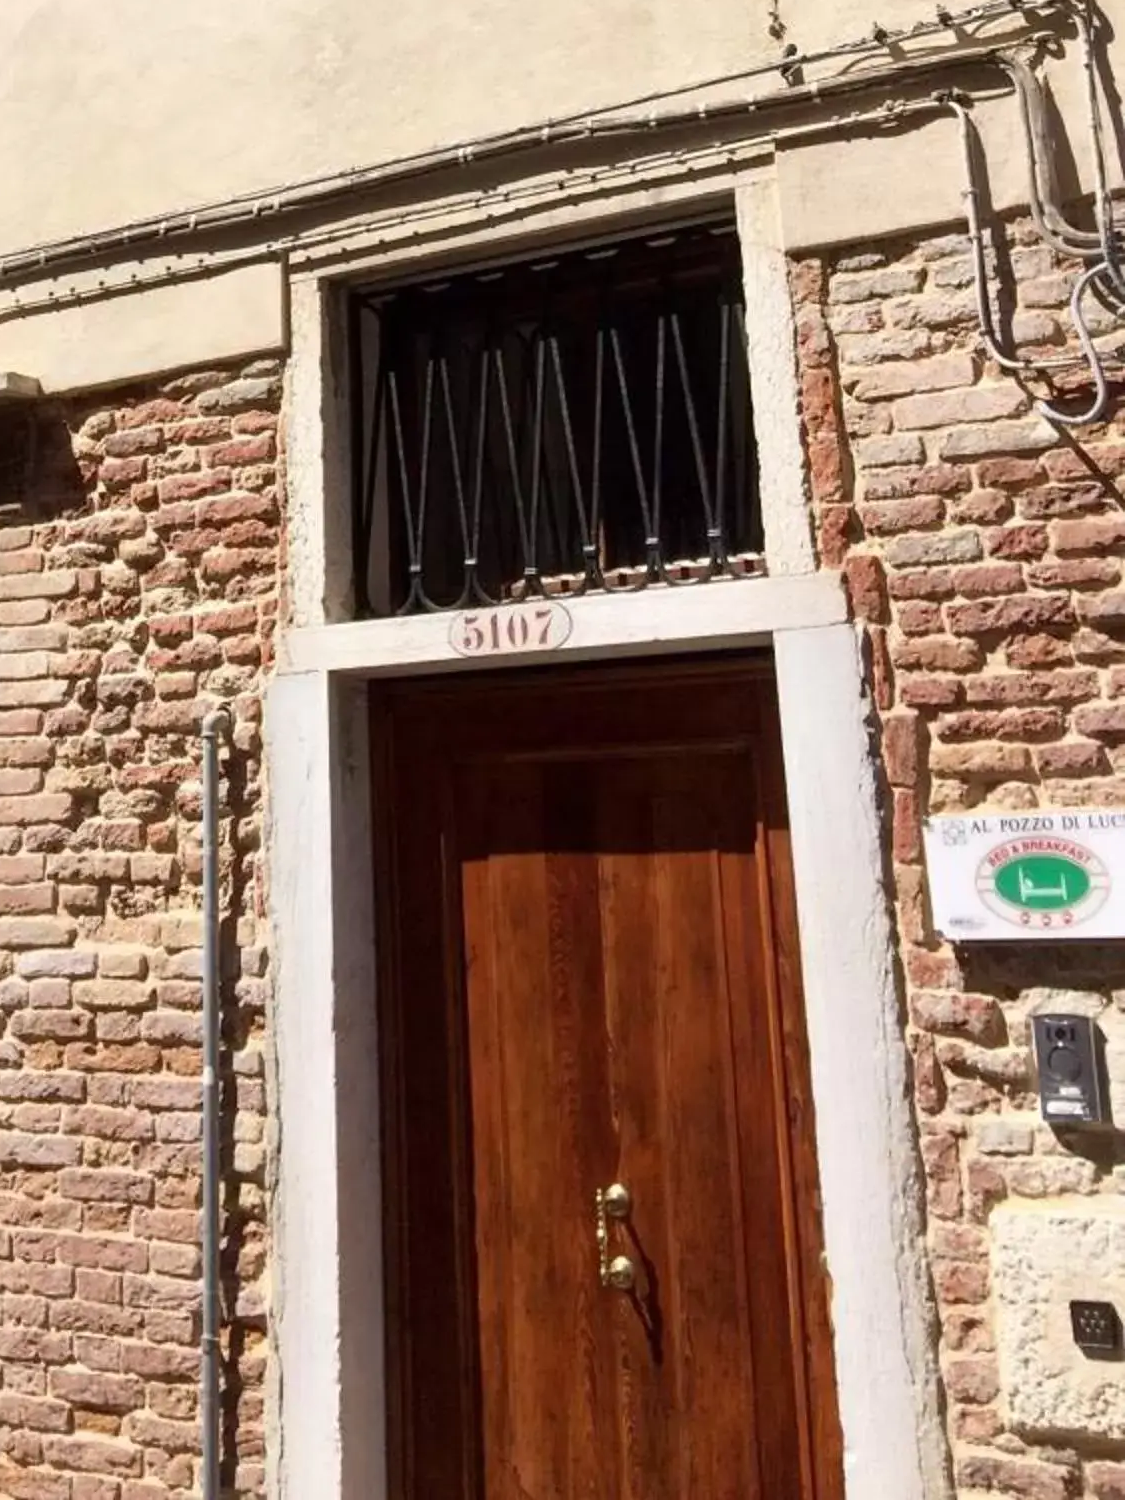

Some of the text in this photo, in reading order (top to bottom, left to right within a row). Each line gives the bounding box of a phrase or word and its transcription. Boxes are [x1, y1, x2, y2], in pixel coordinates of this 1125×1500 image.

[463, 609, 552, 650] 5107
[971, 819, 992, 834] AL
[1000, 817, 1054, 833] POZZO
[1062, 815, 1080, 831] DI
[988, 848, 1010, 867] BED
[1022, 841, 1091, 862] BREAKFAST
